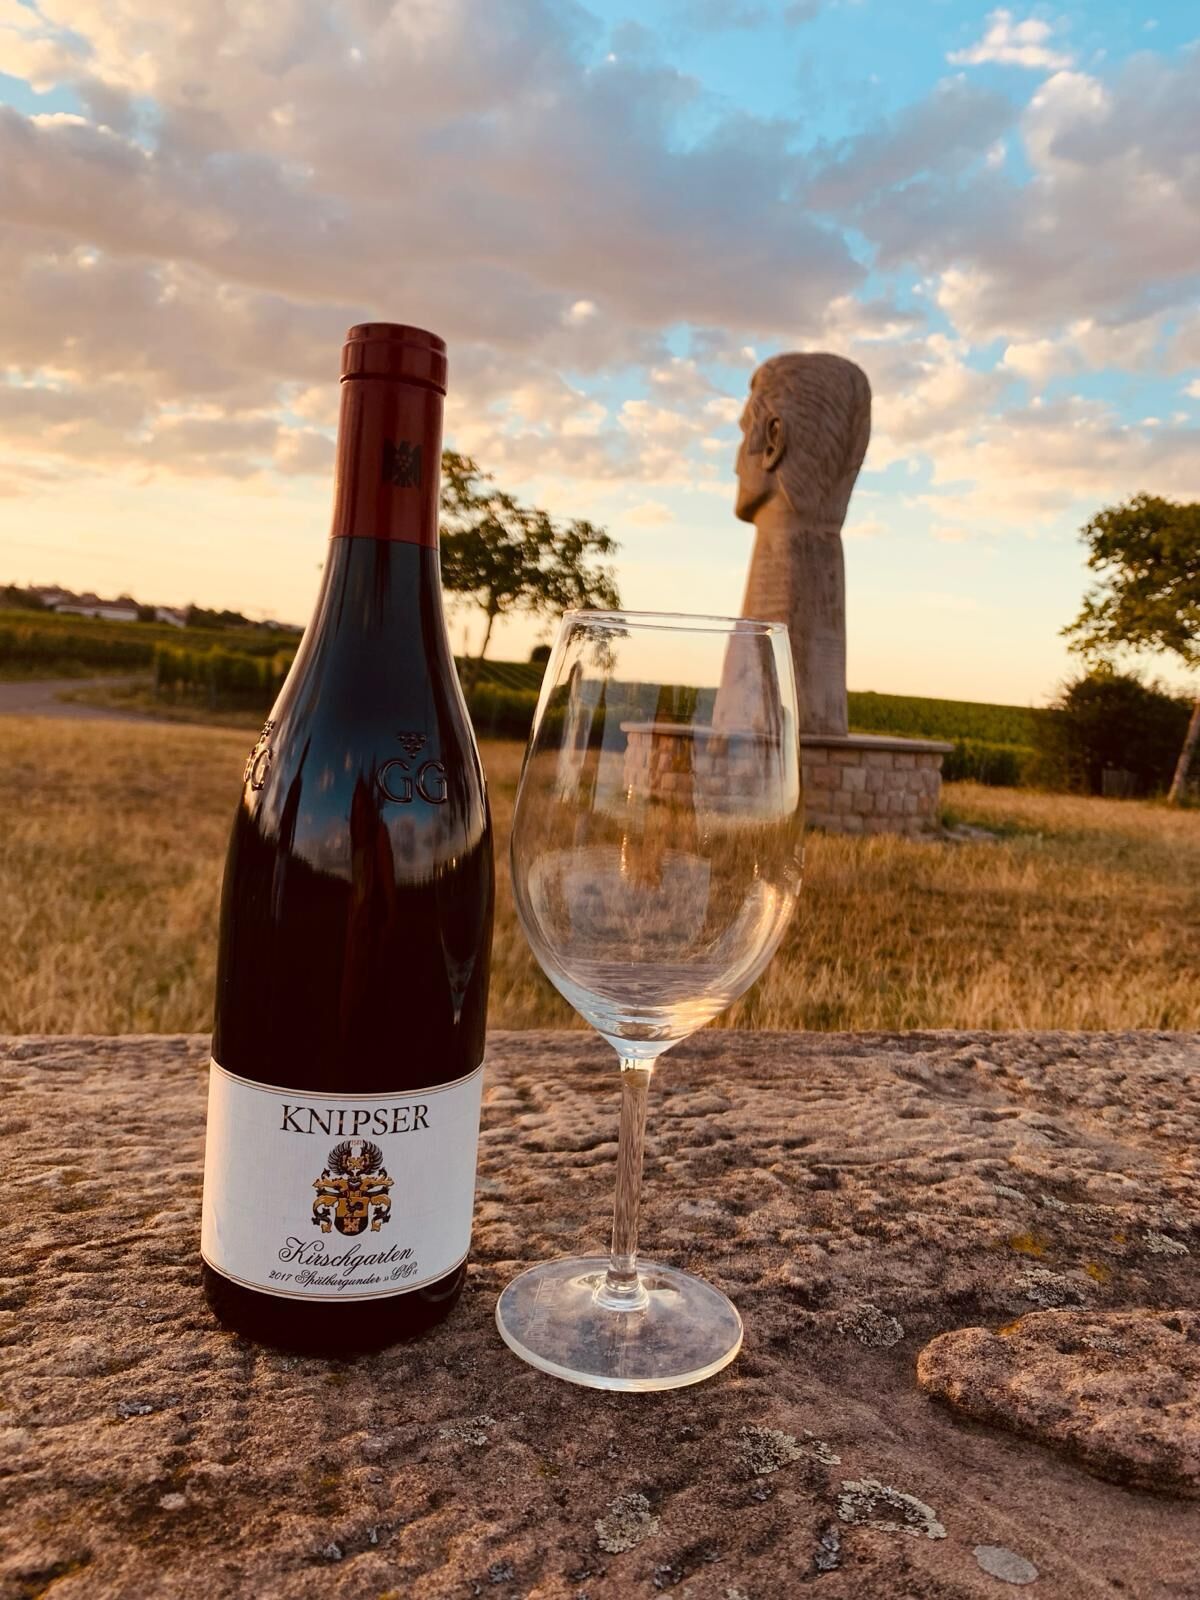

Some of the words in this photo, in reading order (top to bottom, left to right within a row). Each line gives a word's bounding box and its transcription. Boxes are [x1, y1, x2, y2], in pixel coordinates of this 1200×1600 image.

[376, 758, 448, 805] GG
[280, 1104, 430, 1136] KNIPSER
[278, 1236, 414, 1277] Kirschgarten
[268, 1270, 293, 1282] 2017
[295, 1269, 381, 1291] Spätburgunder
